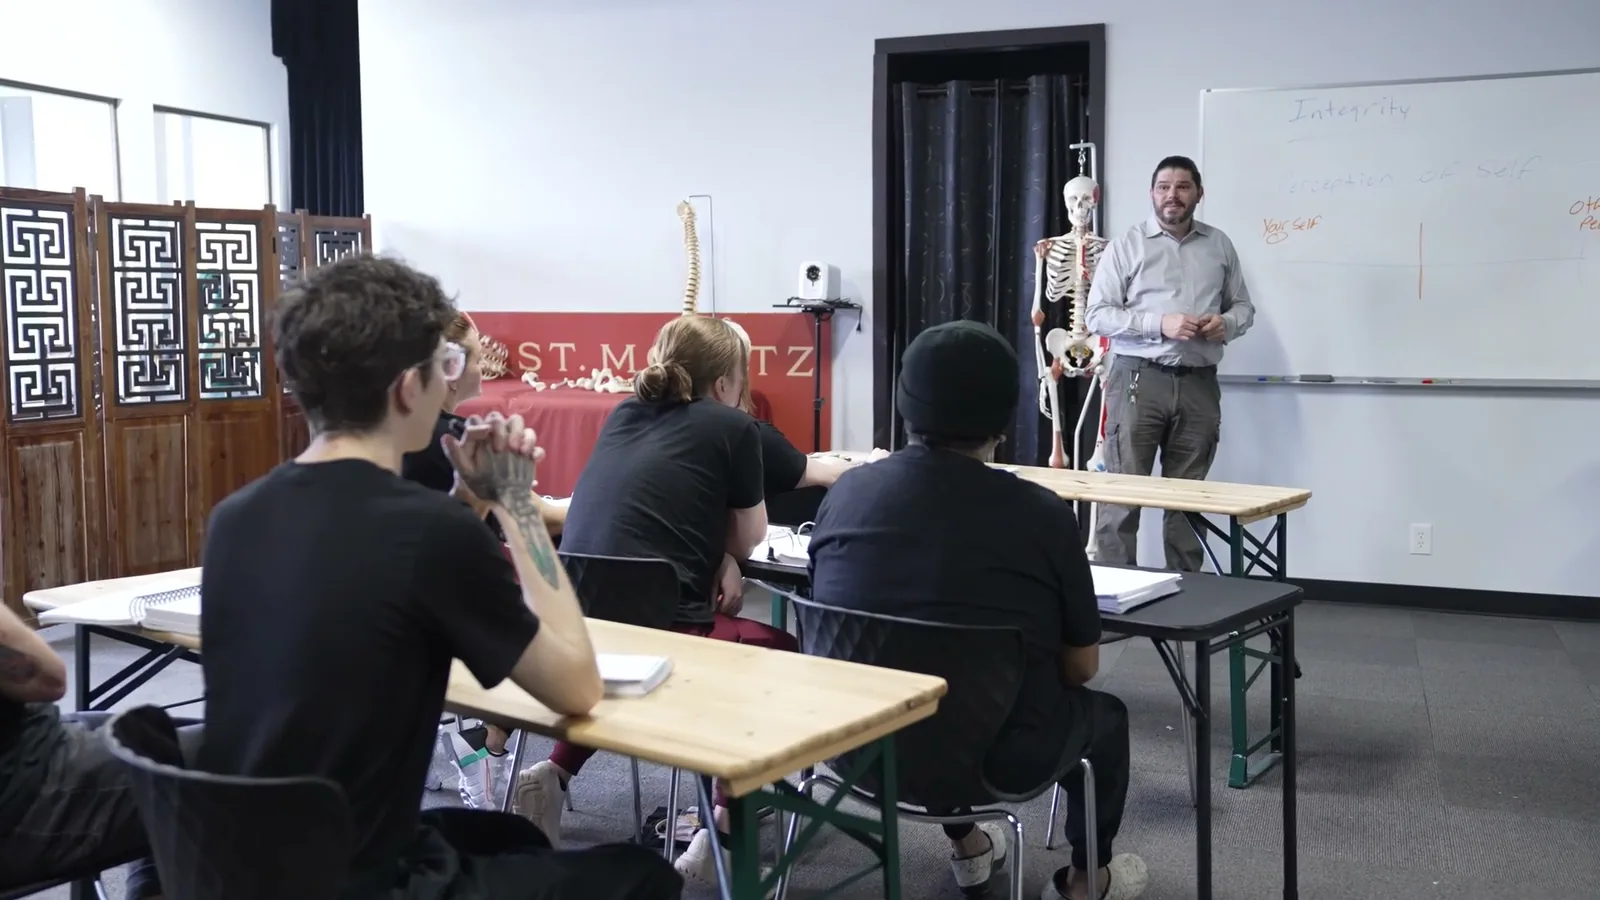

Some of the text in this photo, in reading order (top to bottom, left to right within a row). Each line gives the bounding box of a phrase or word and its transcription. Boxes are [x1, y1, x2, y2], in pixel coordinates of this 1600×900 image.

[1288, 95, 1411, 123] Integrity
[1579, 215, 1600, 231] Pe
[518, 341, 815, 377] ST. MTZ
